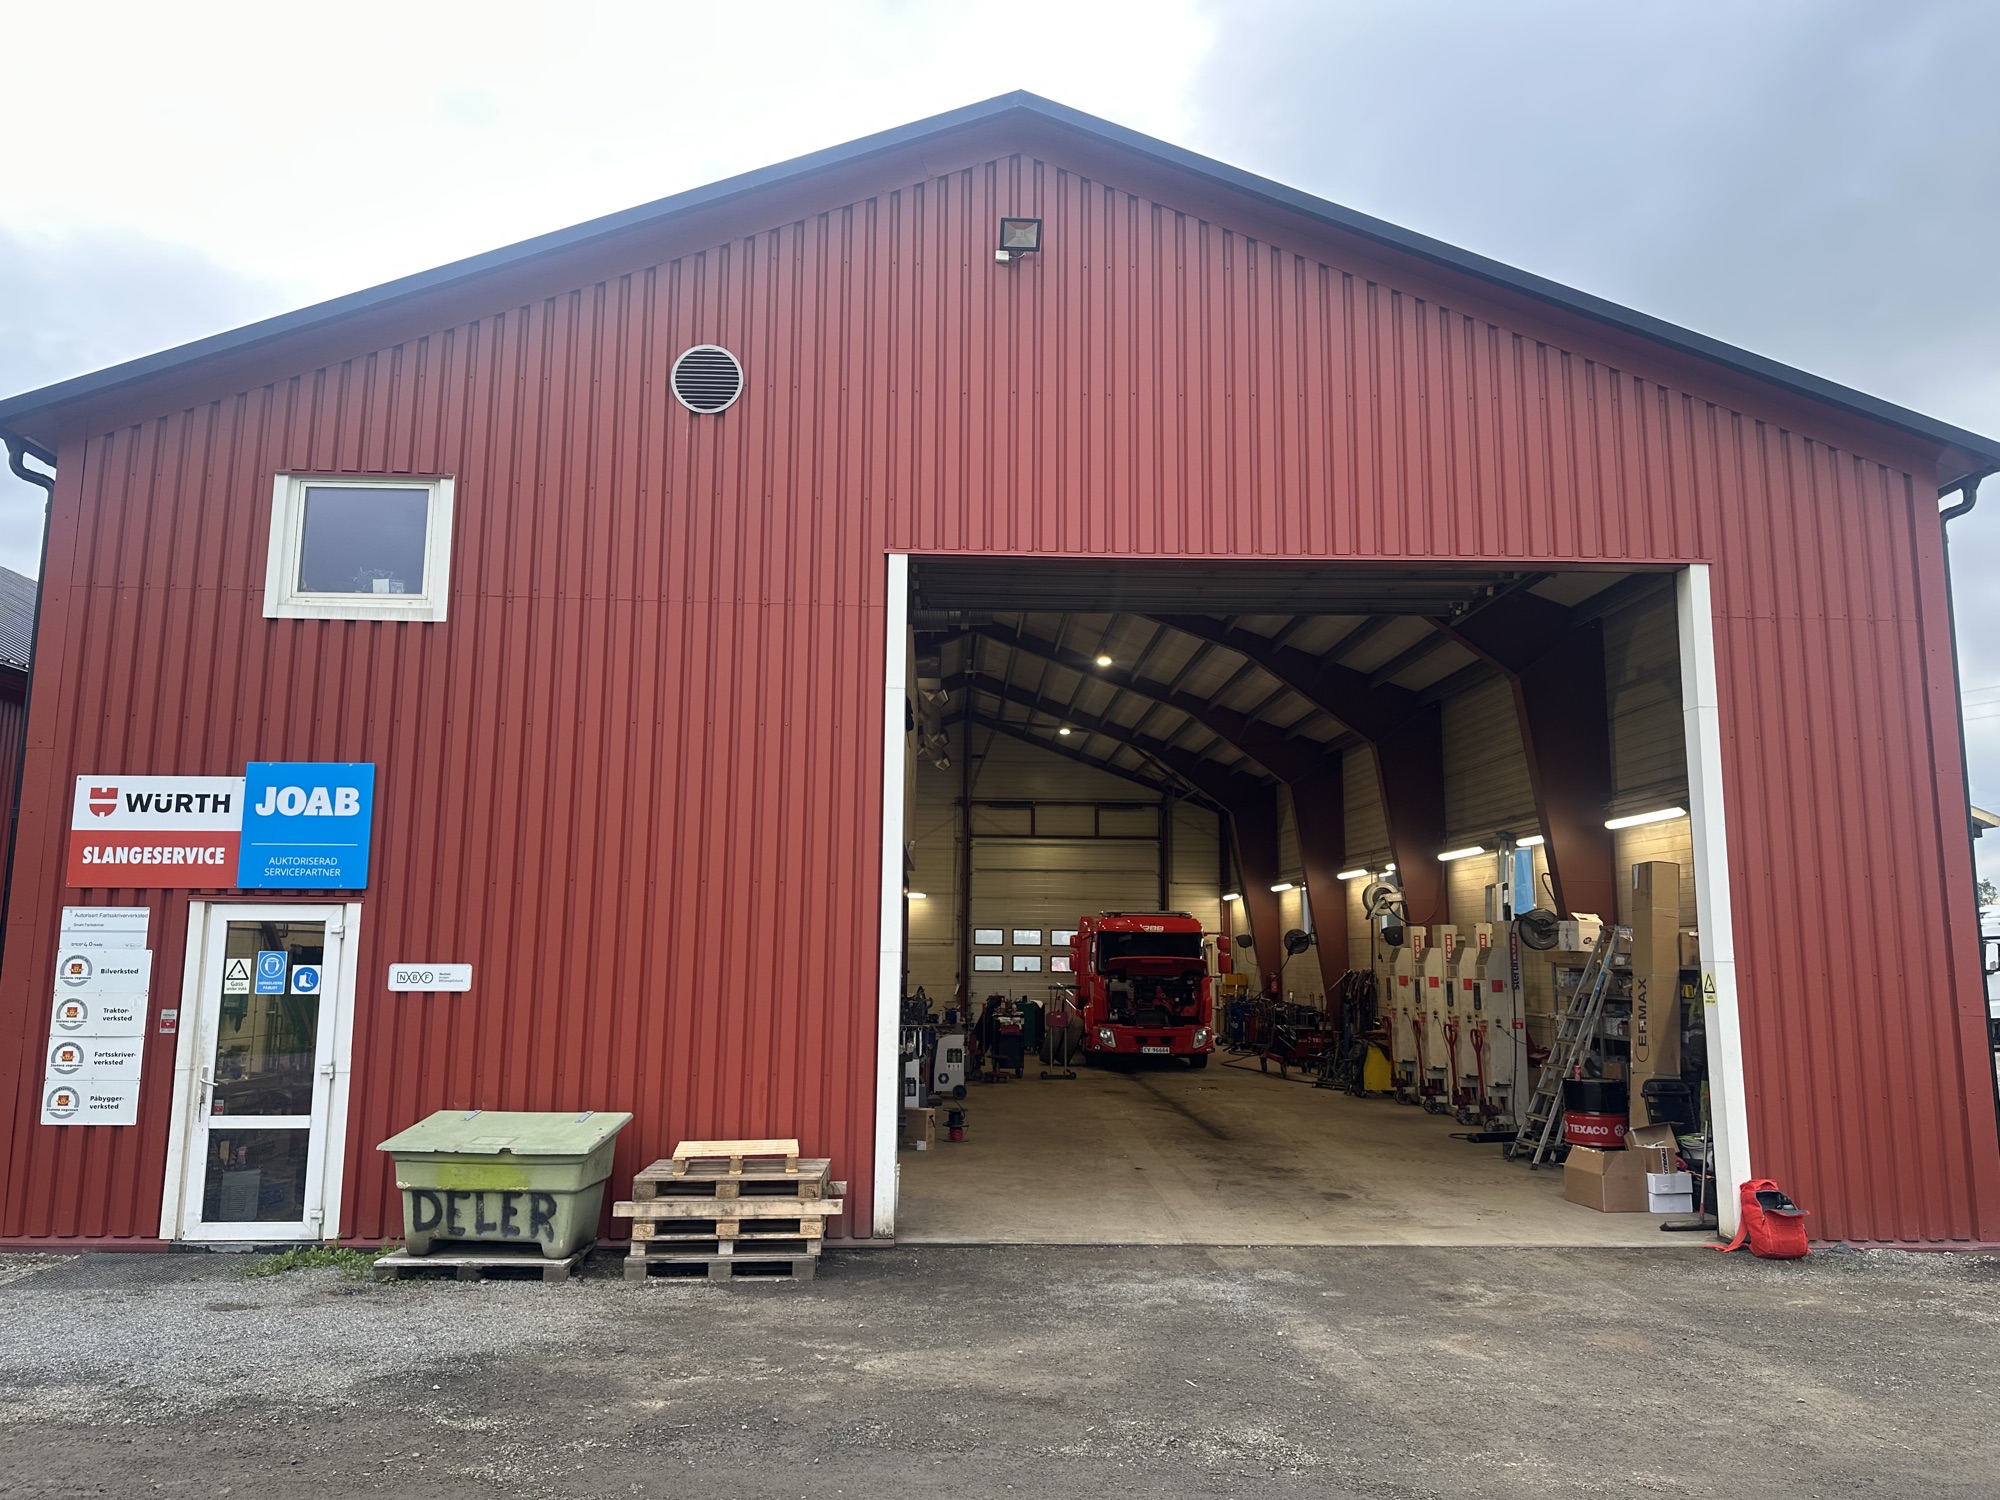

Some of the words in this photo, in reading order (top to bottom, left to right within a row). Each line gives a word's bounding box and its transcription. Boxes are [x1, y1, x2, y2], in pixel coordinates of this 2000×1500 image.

[126, 793, 231, 813] WÜRTH
[255, 786, 360, 816] JOAB
[82, 846, 225, 865] SLANGESERVICE
[268, 857, 338, 866] AUKTORISERAD
[264, 868, 341, 877] SERVICEPARTNER
[398, 973, 431, 982] NBF
[1570, 1124, 1608, 1135] TEXACO
[412, 1190, 557, 1243] DELER
